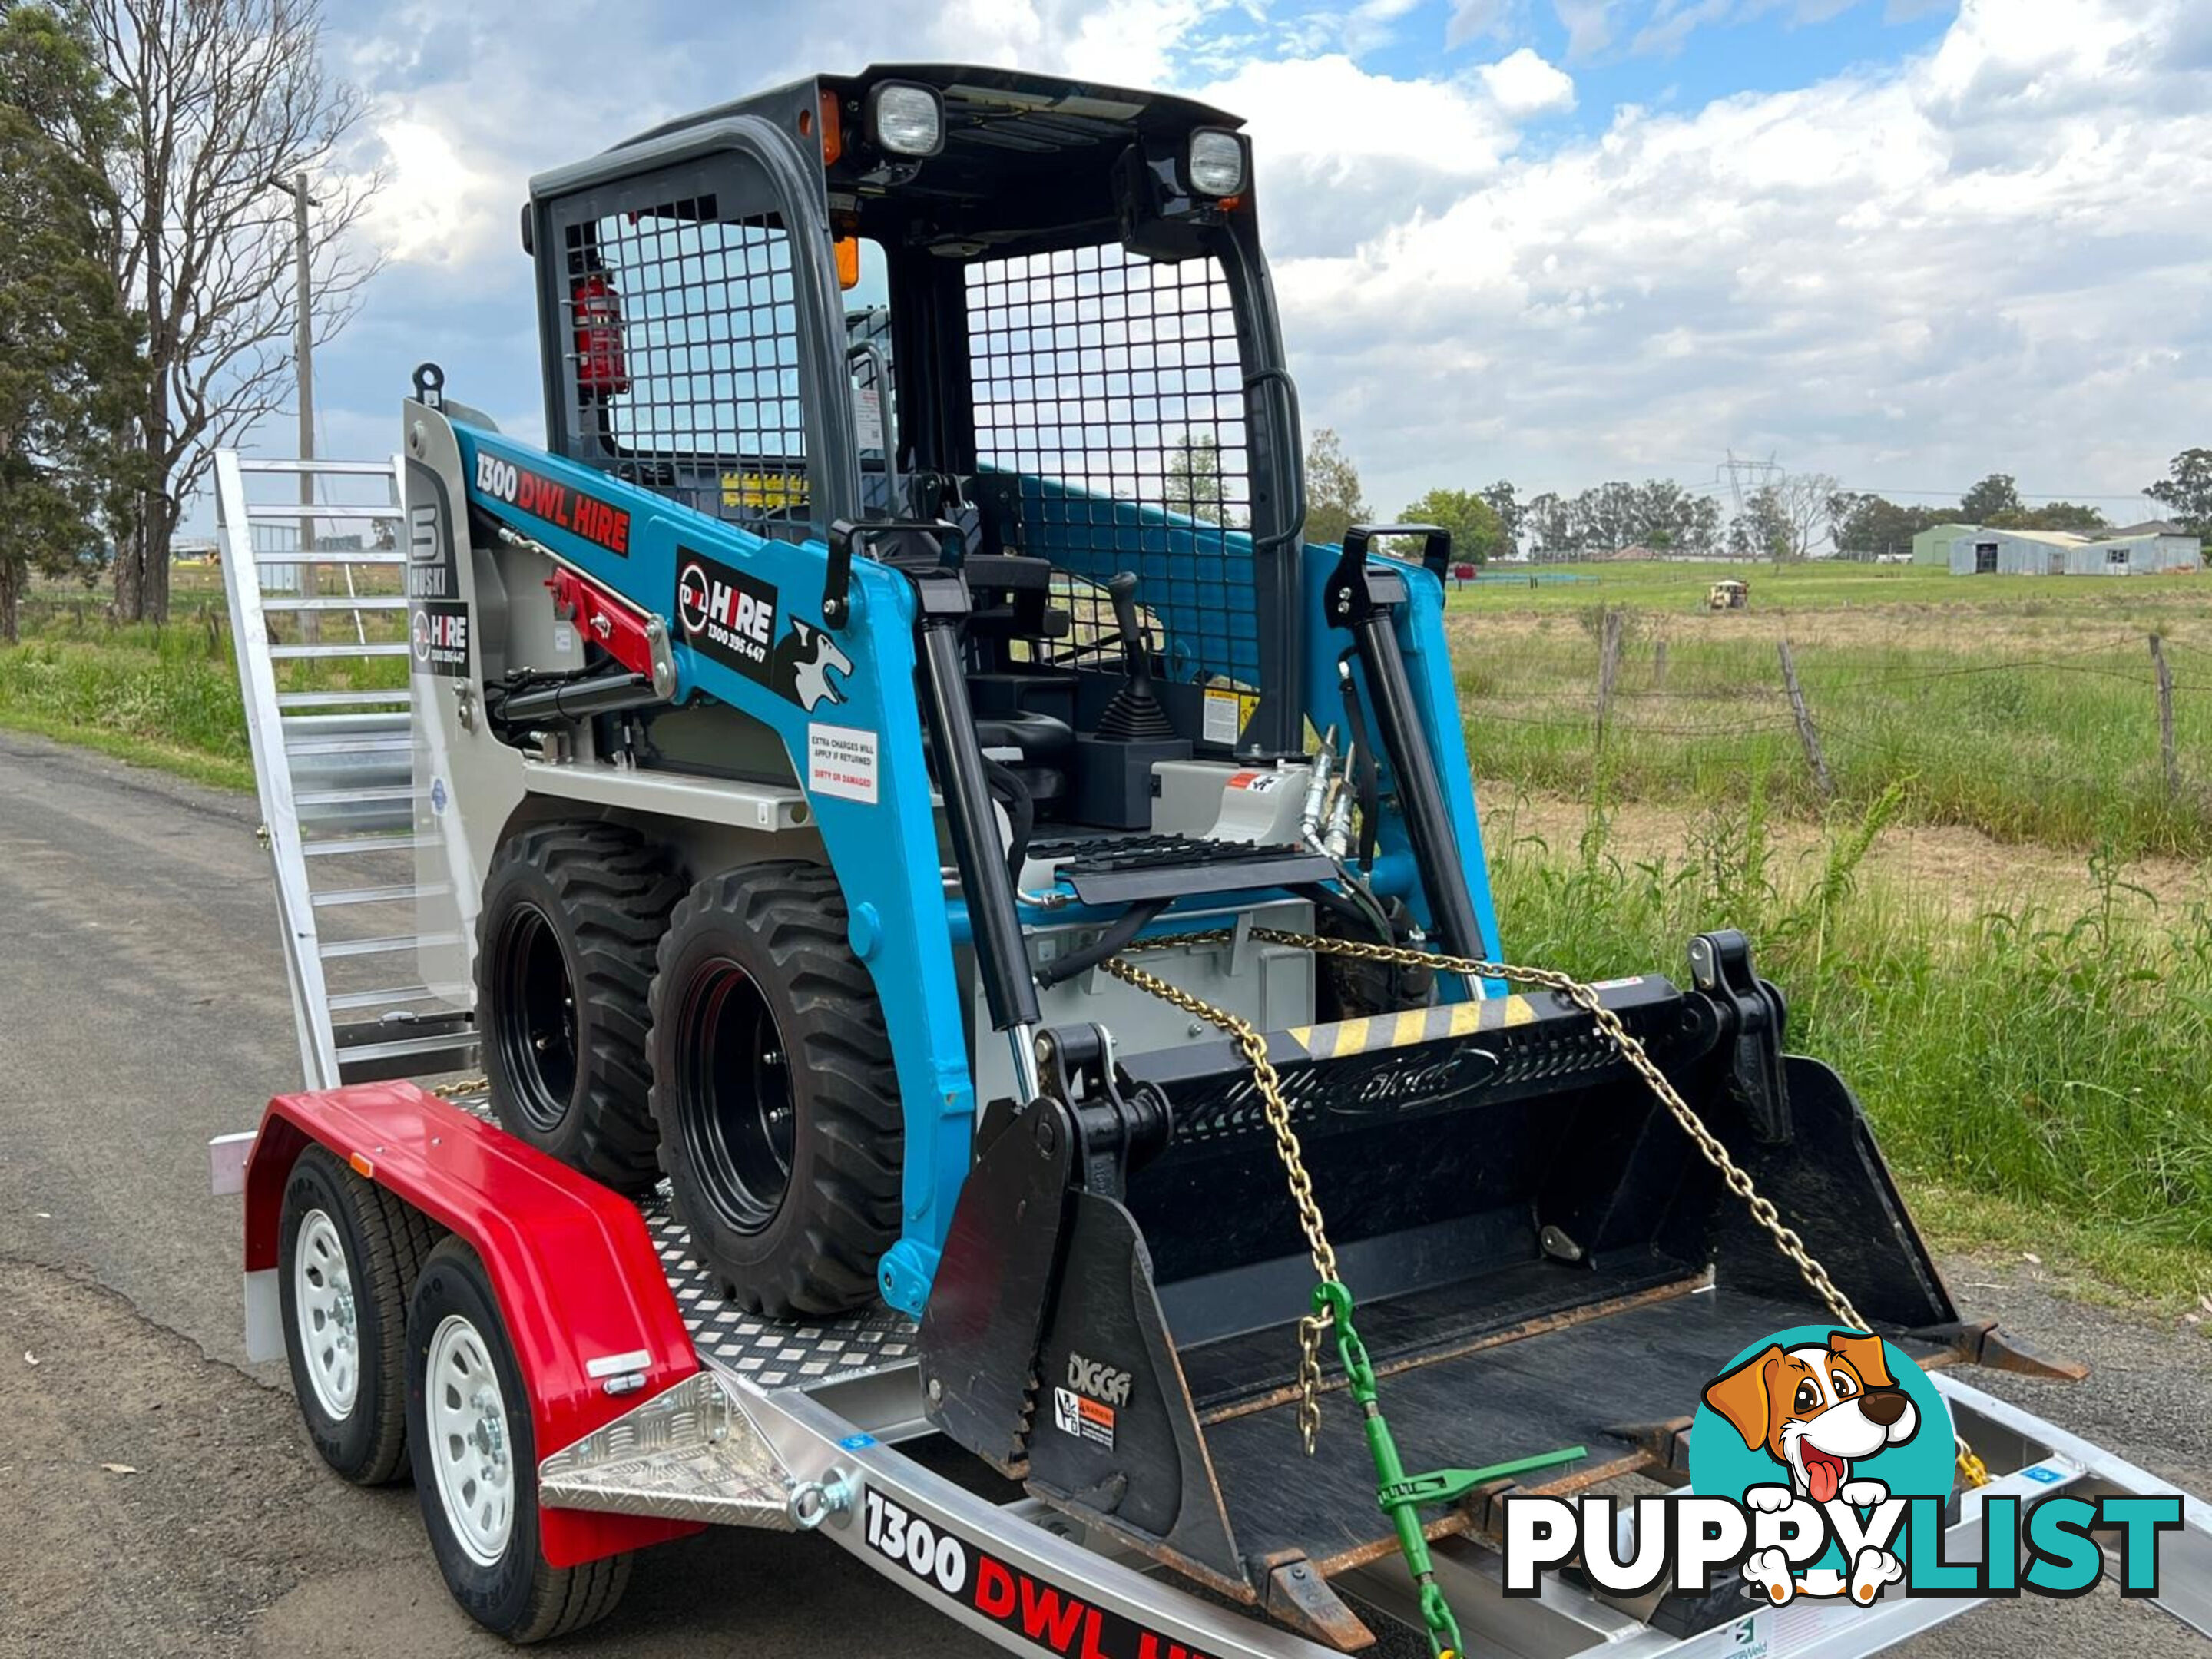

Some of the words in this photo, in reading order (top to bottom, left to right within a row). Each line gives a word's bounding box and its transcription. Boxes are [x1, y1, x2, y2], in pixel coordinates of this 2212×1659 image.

[477, 452, 518, 502] 1300
[518, 471, 569, 526] DWL
[572, 494, 631, 555] HIRE
[431, 614, 466, 647] HIRE
[710, 580, 773, 645] HIRE
[707, 622, 729, 645] 1300
[727, 632, 747, 654] 395
[746, 642, 766, 664] 447
[811, 736, 830, 747] EXTRA
[831, 739, 859, 751] CHARGES
[859, 743, 874, 754] WILL
[814, 748, 831, 759] APPLY
[839, 752, 872, 766] RETURNED
[814, 769, 831, 779] DIRTY
[842, 774, 872, 788] DAMAGED
[1068, 1351, 1132, 1407] DIGGA
[866, 1489, 966, 1594] 1300
[975, 1555, 1110, 1659] DWL
